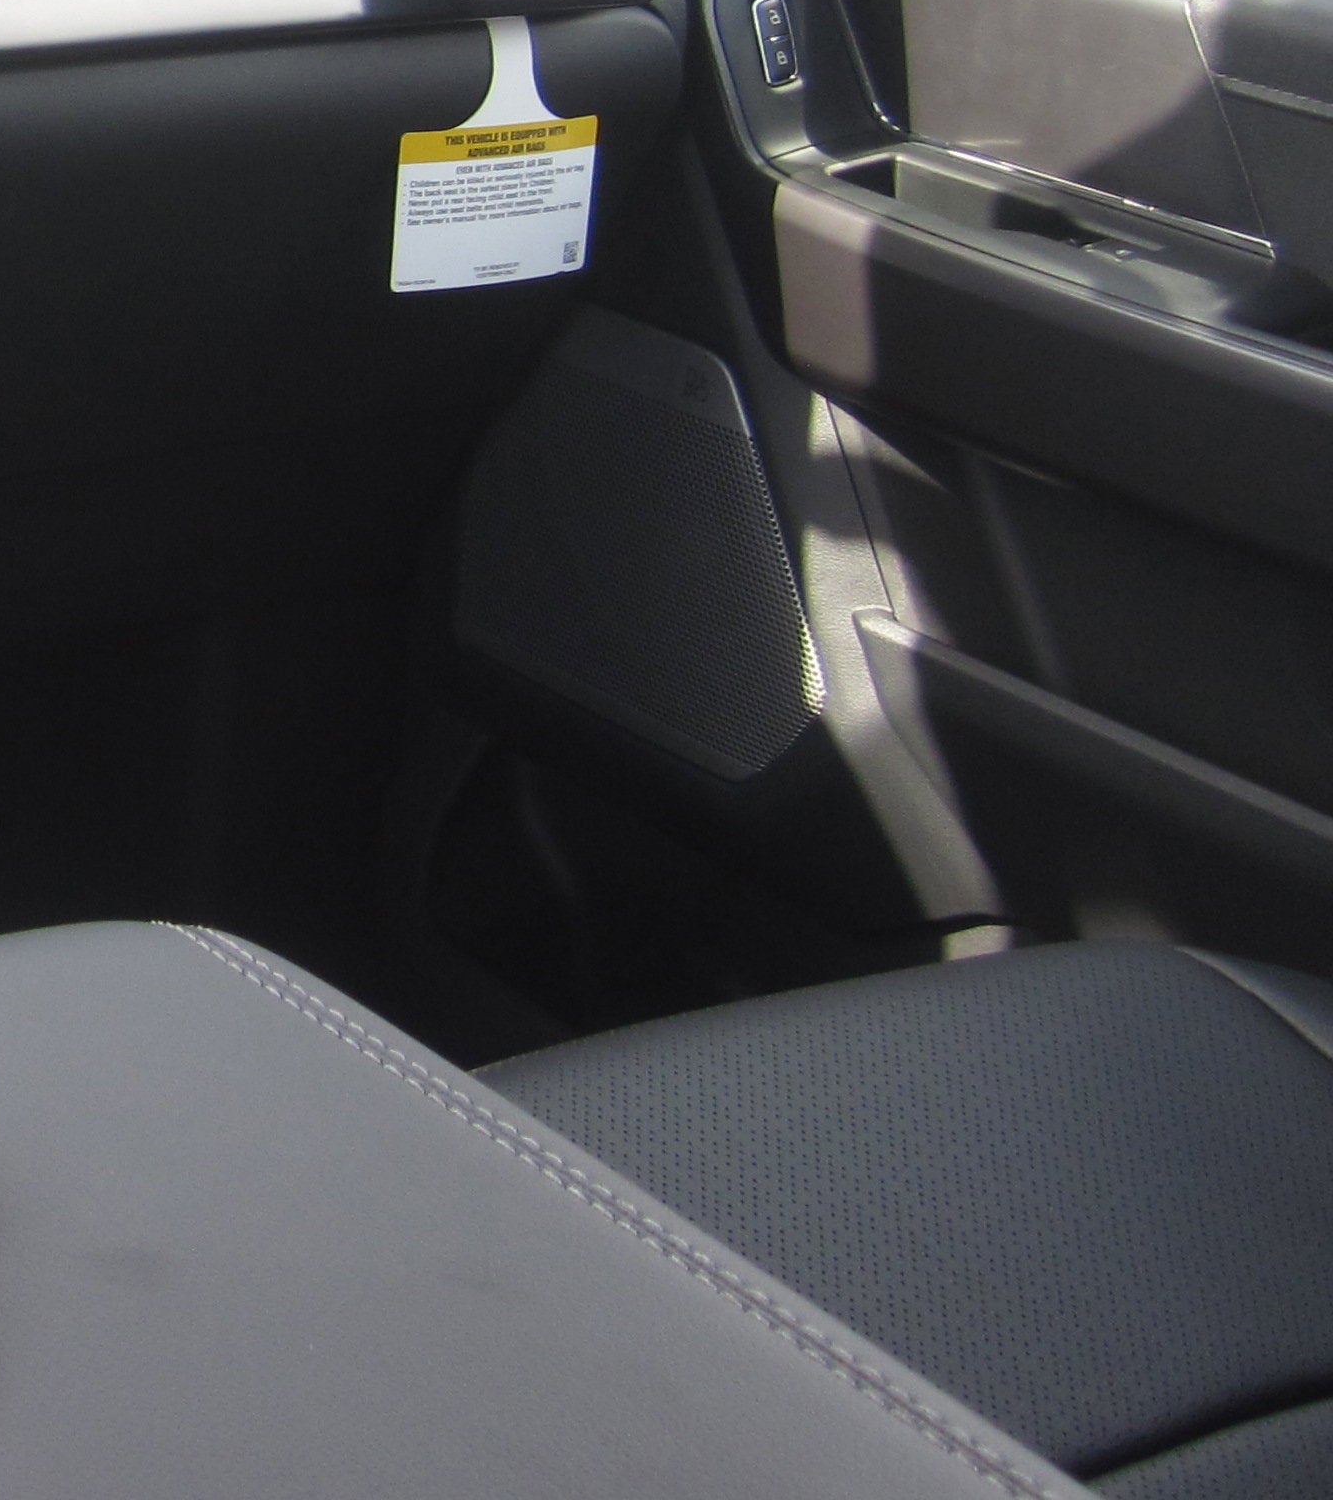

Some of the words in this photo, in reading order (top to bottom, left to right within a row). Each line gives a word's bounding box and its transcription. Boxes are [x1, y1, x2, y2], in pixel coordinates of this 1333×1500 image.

[445, 134, 465, 146] THIS
[466, 132, 500, 145] VEHICLE
[510, 128, 547, 141] EQUIPPED
[549, 125, 568, 136] WITH
[467, 146, 511, 158] ADVANCED
[511, 143, 525, 155] AIR
[526, 141, 546, 154] BAGS
